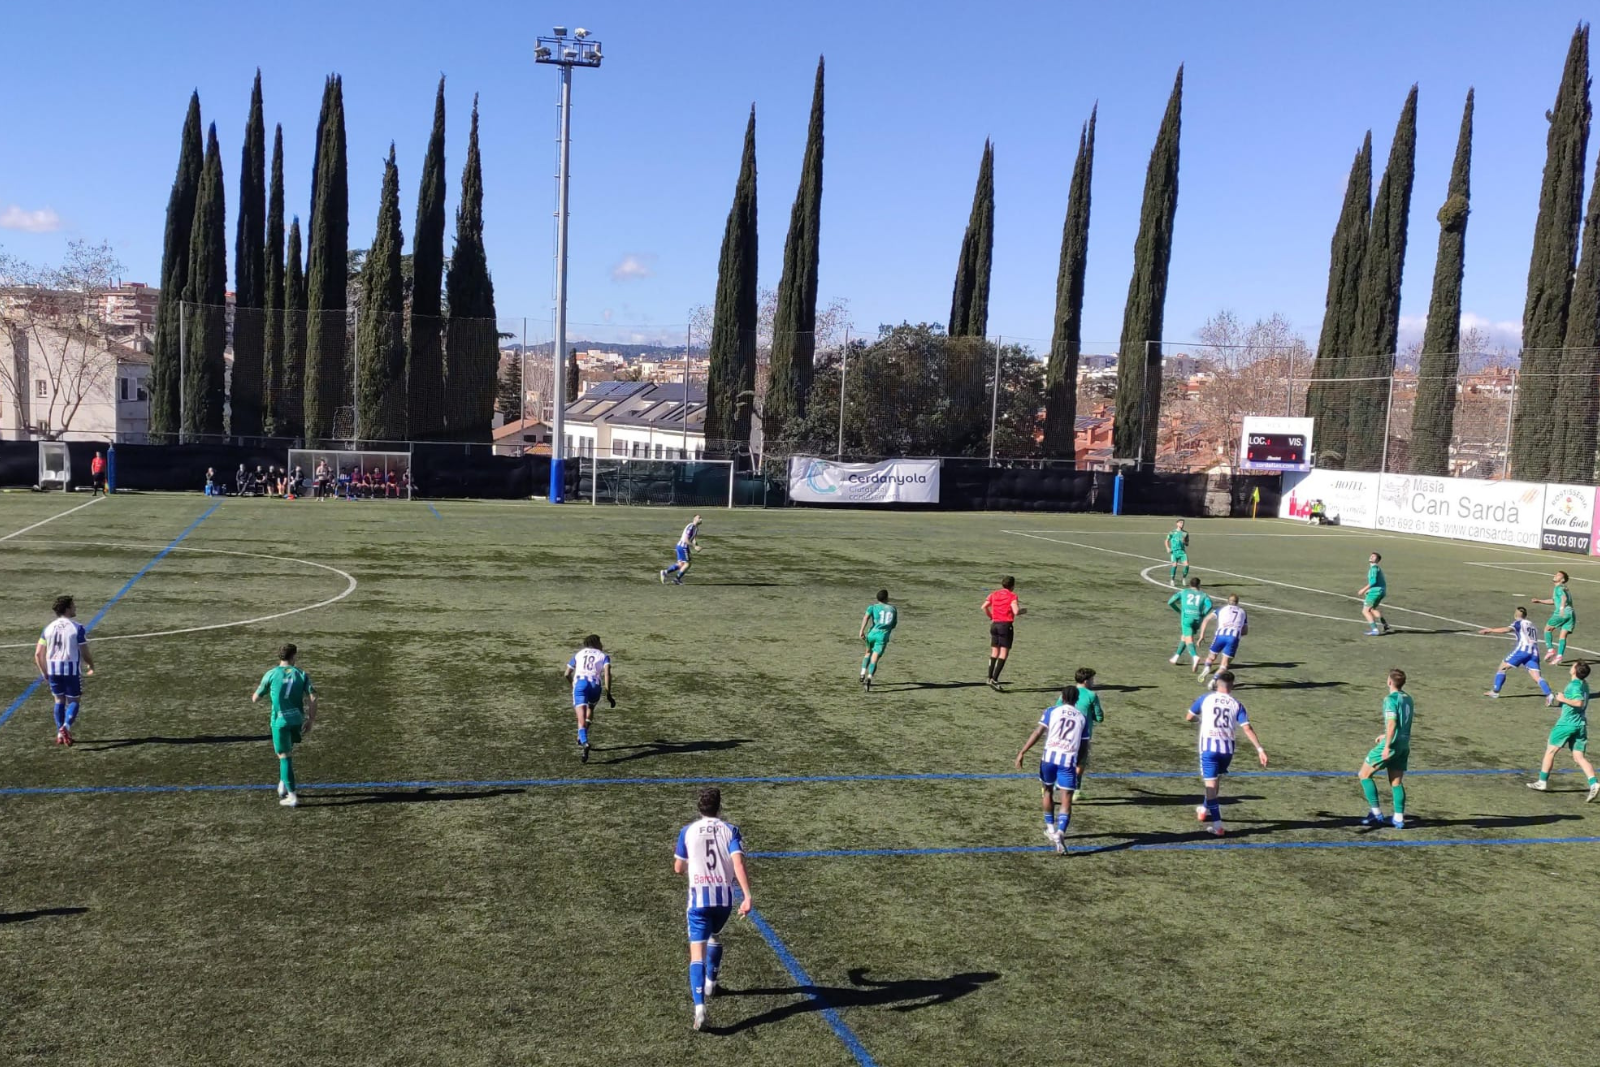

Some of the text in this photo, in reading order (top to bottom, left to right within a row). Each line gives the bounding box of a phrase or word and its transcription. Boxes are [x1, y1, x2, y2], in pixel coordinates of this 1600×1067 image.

[1249, 436, 1267, 445] LOC.
[1288, 437, 1303, 446] VIS.
[848, 473, 926, 486] Cerdanyola
[1411, 492, 1519, 524] Can Sardà
[1545, 513, 1567, 526] Casa
[1385, 516, 1539, 545] 93 692 61 85 www.cansarda.com
[1543, 533, 1557, 546] 633
[1557, 535, 1567, 546] 03
[1568, 536, 1577, 548] 81
[1577, 537, 1589, 549] 07
[1186, 593, 1200, 607] 21
[1232, 610, 1239, 623] 7
[583, 655, 595, 671] 18
[282, 678, 294, 699] 7
[1062, 709, 1077, 717] FCV
[1213, 706, 1230, 728] 25
[1059, 717, 1076, 740] 12
[705, 839, 717, 871] 5
